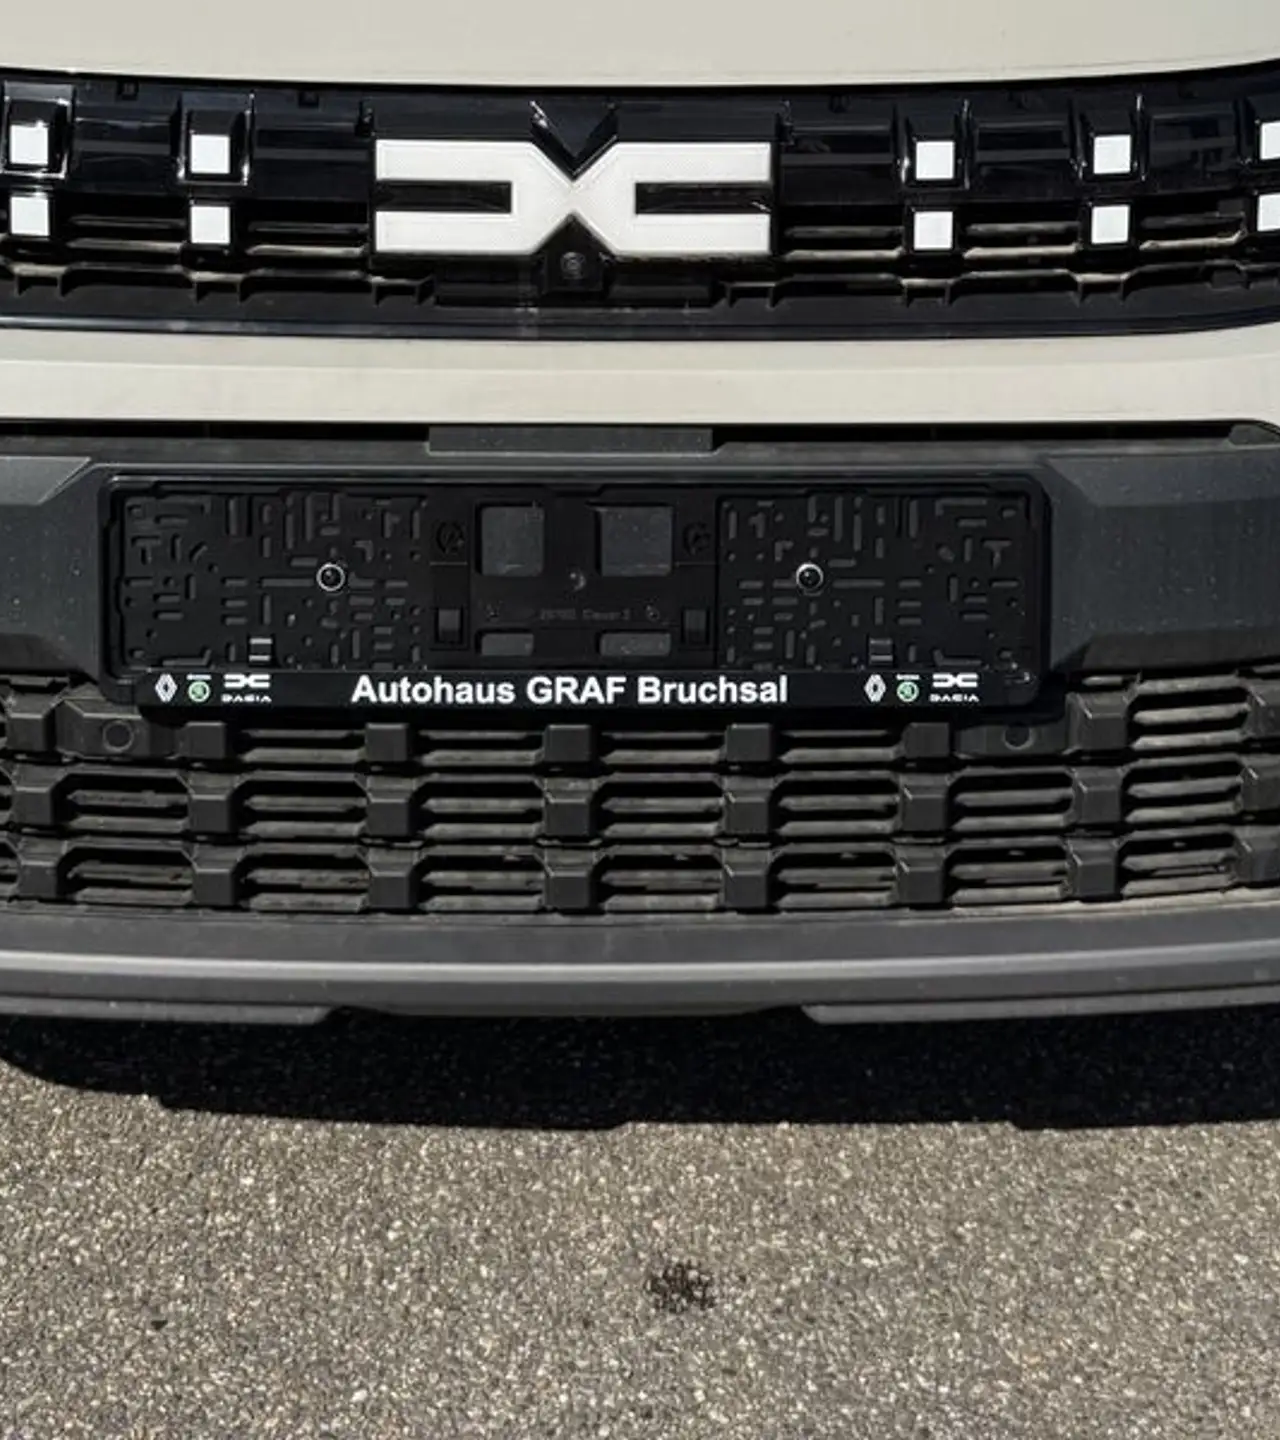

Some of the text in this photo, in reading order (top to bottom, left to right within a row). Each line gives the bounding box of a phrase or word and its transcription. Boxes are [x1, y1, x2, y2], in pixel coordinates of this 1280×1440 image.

[351, 675, 787, 704] Autohaus GRAF Bruchsal
